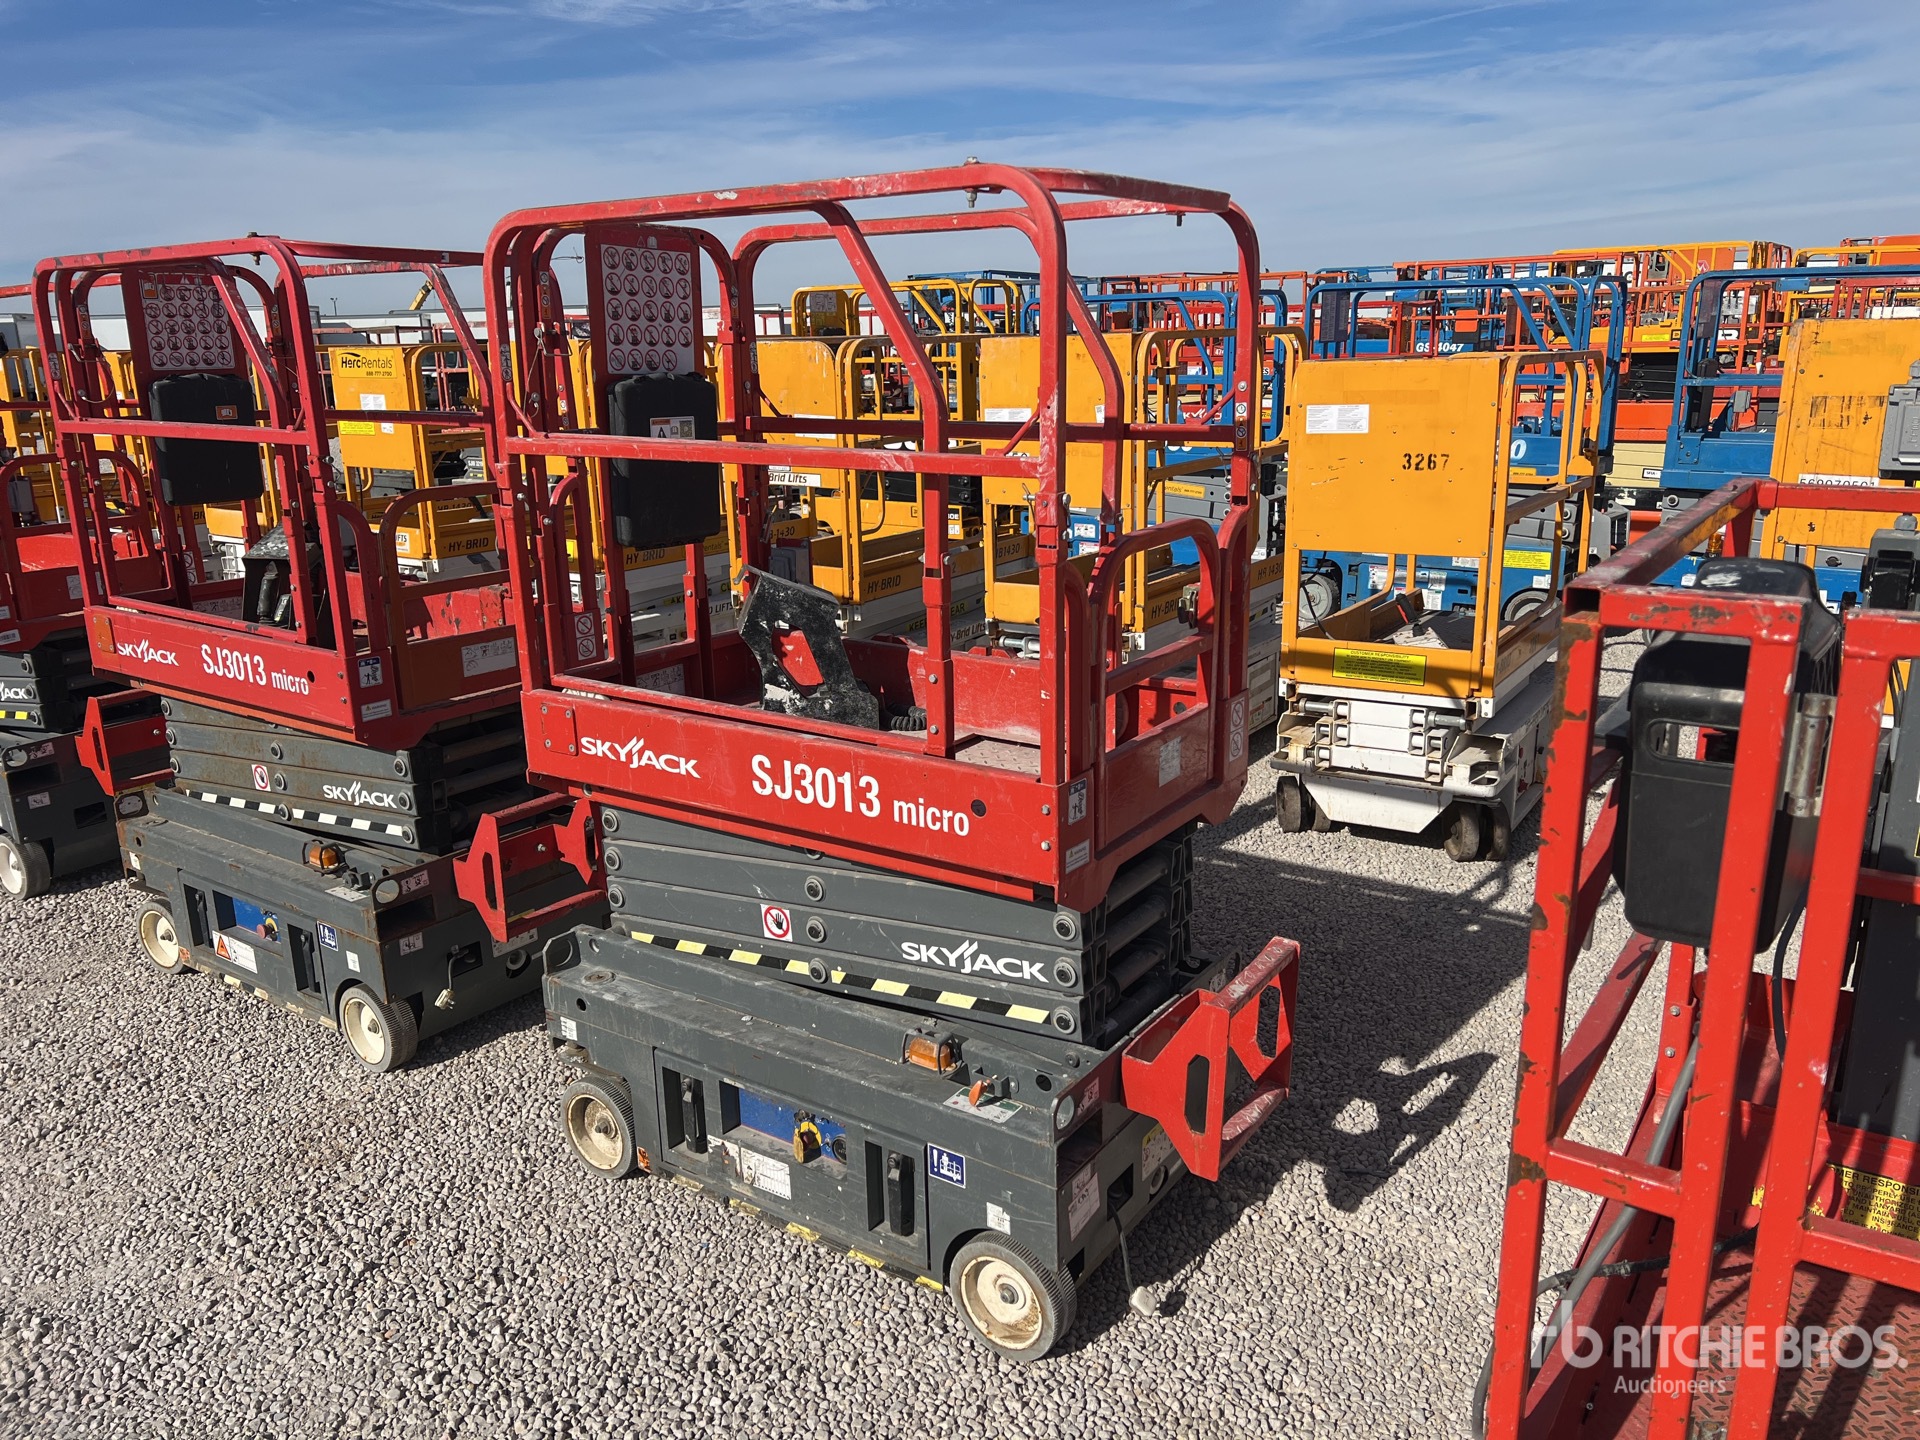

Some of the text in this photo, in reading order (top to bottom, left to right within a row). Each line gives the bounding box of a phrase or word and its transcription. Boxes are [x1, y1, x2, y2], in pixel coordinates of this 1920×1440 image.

[341, 356, 393, 369] HercRentals
[1402, 453, 1450, 471] 3267
[769, 472, 807, 484] Brid Lifts
[448, 537, 489, 552] HY-BRID
[1151, 598, 1180, 620] HY-BRI
[116, 639, 309, 696] SKYJACK SJ3013 micro
[322, 780, 398, 809] SKYJACK
[580, 736, 970, 837] SKYJACK SJ3013 micro
[901, 939, 1050, 984] SKYJACK
[1863, 1175, 1920, 1195] RESPONSI
